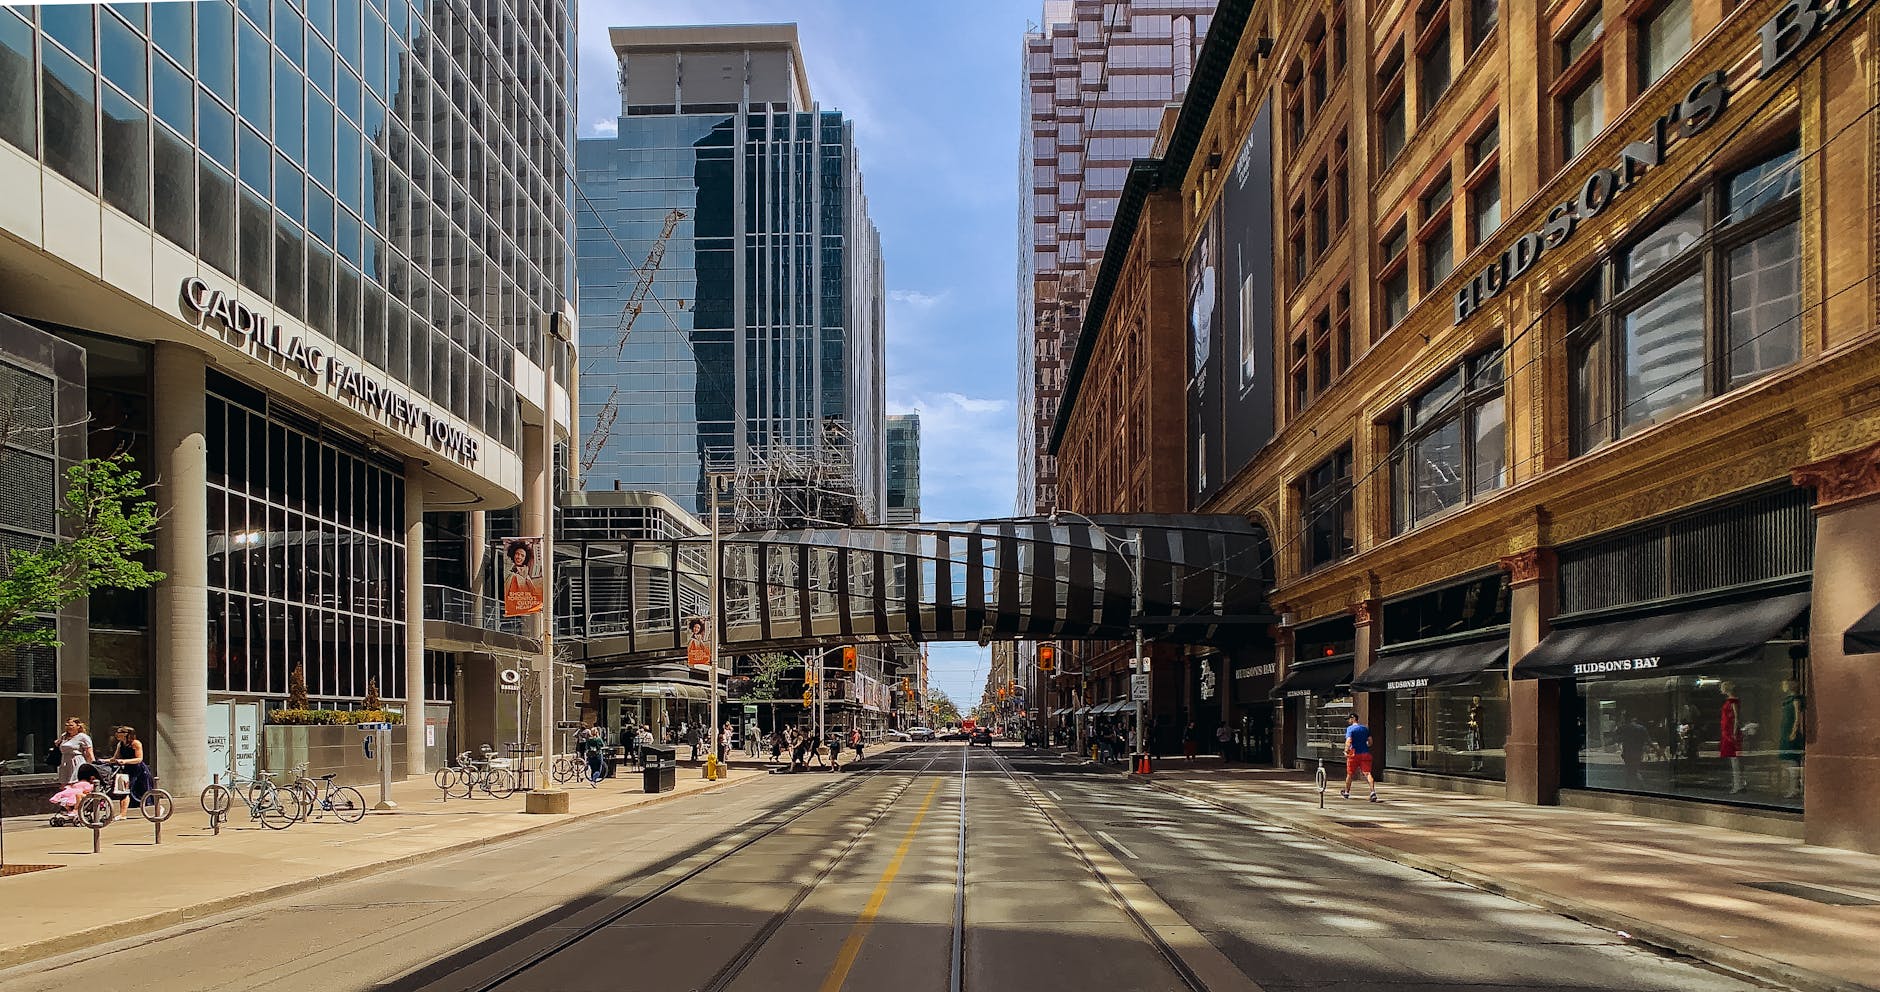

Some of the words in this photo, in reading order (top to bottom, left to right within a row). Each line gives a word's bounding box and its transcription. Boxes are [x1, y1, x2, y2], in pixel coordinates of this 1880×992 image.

[1454, 70, 1727, 326] HUDSON'S
[180, 277, 325, 375] CADILLAC
[327, 357, 422, 428] FAIRVIEW
[423, 412, 479, 461] TOWER
[1236, 665, 1262, 679] HUDSON'S
[1263, 663, 1276, 674] BAY
[1574, 660, 1631, 674] HUDSON'S
[1633, 657, 1660, 669] BAY
[1387, 680, 1415, 689] HUDSON'S
[1416, 678, 1429, 687] BAY
